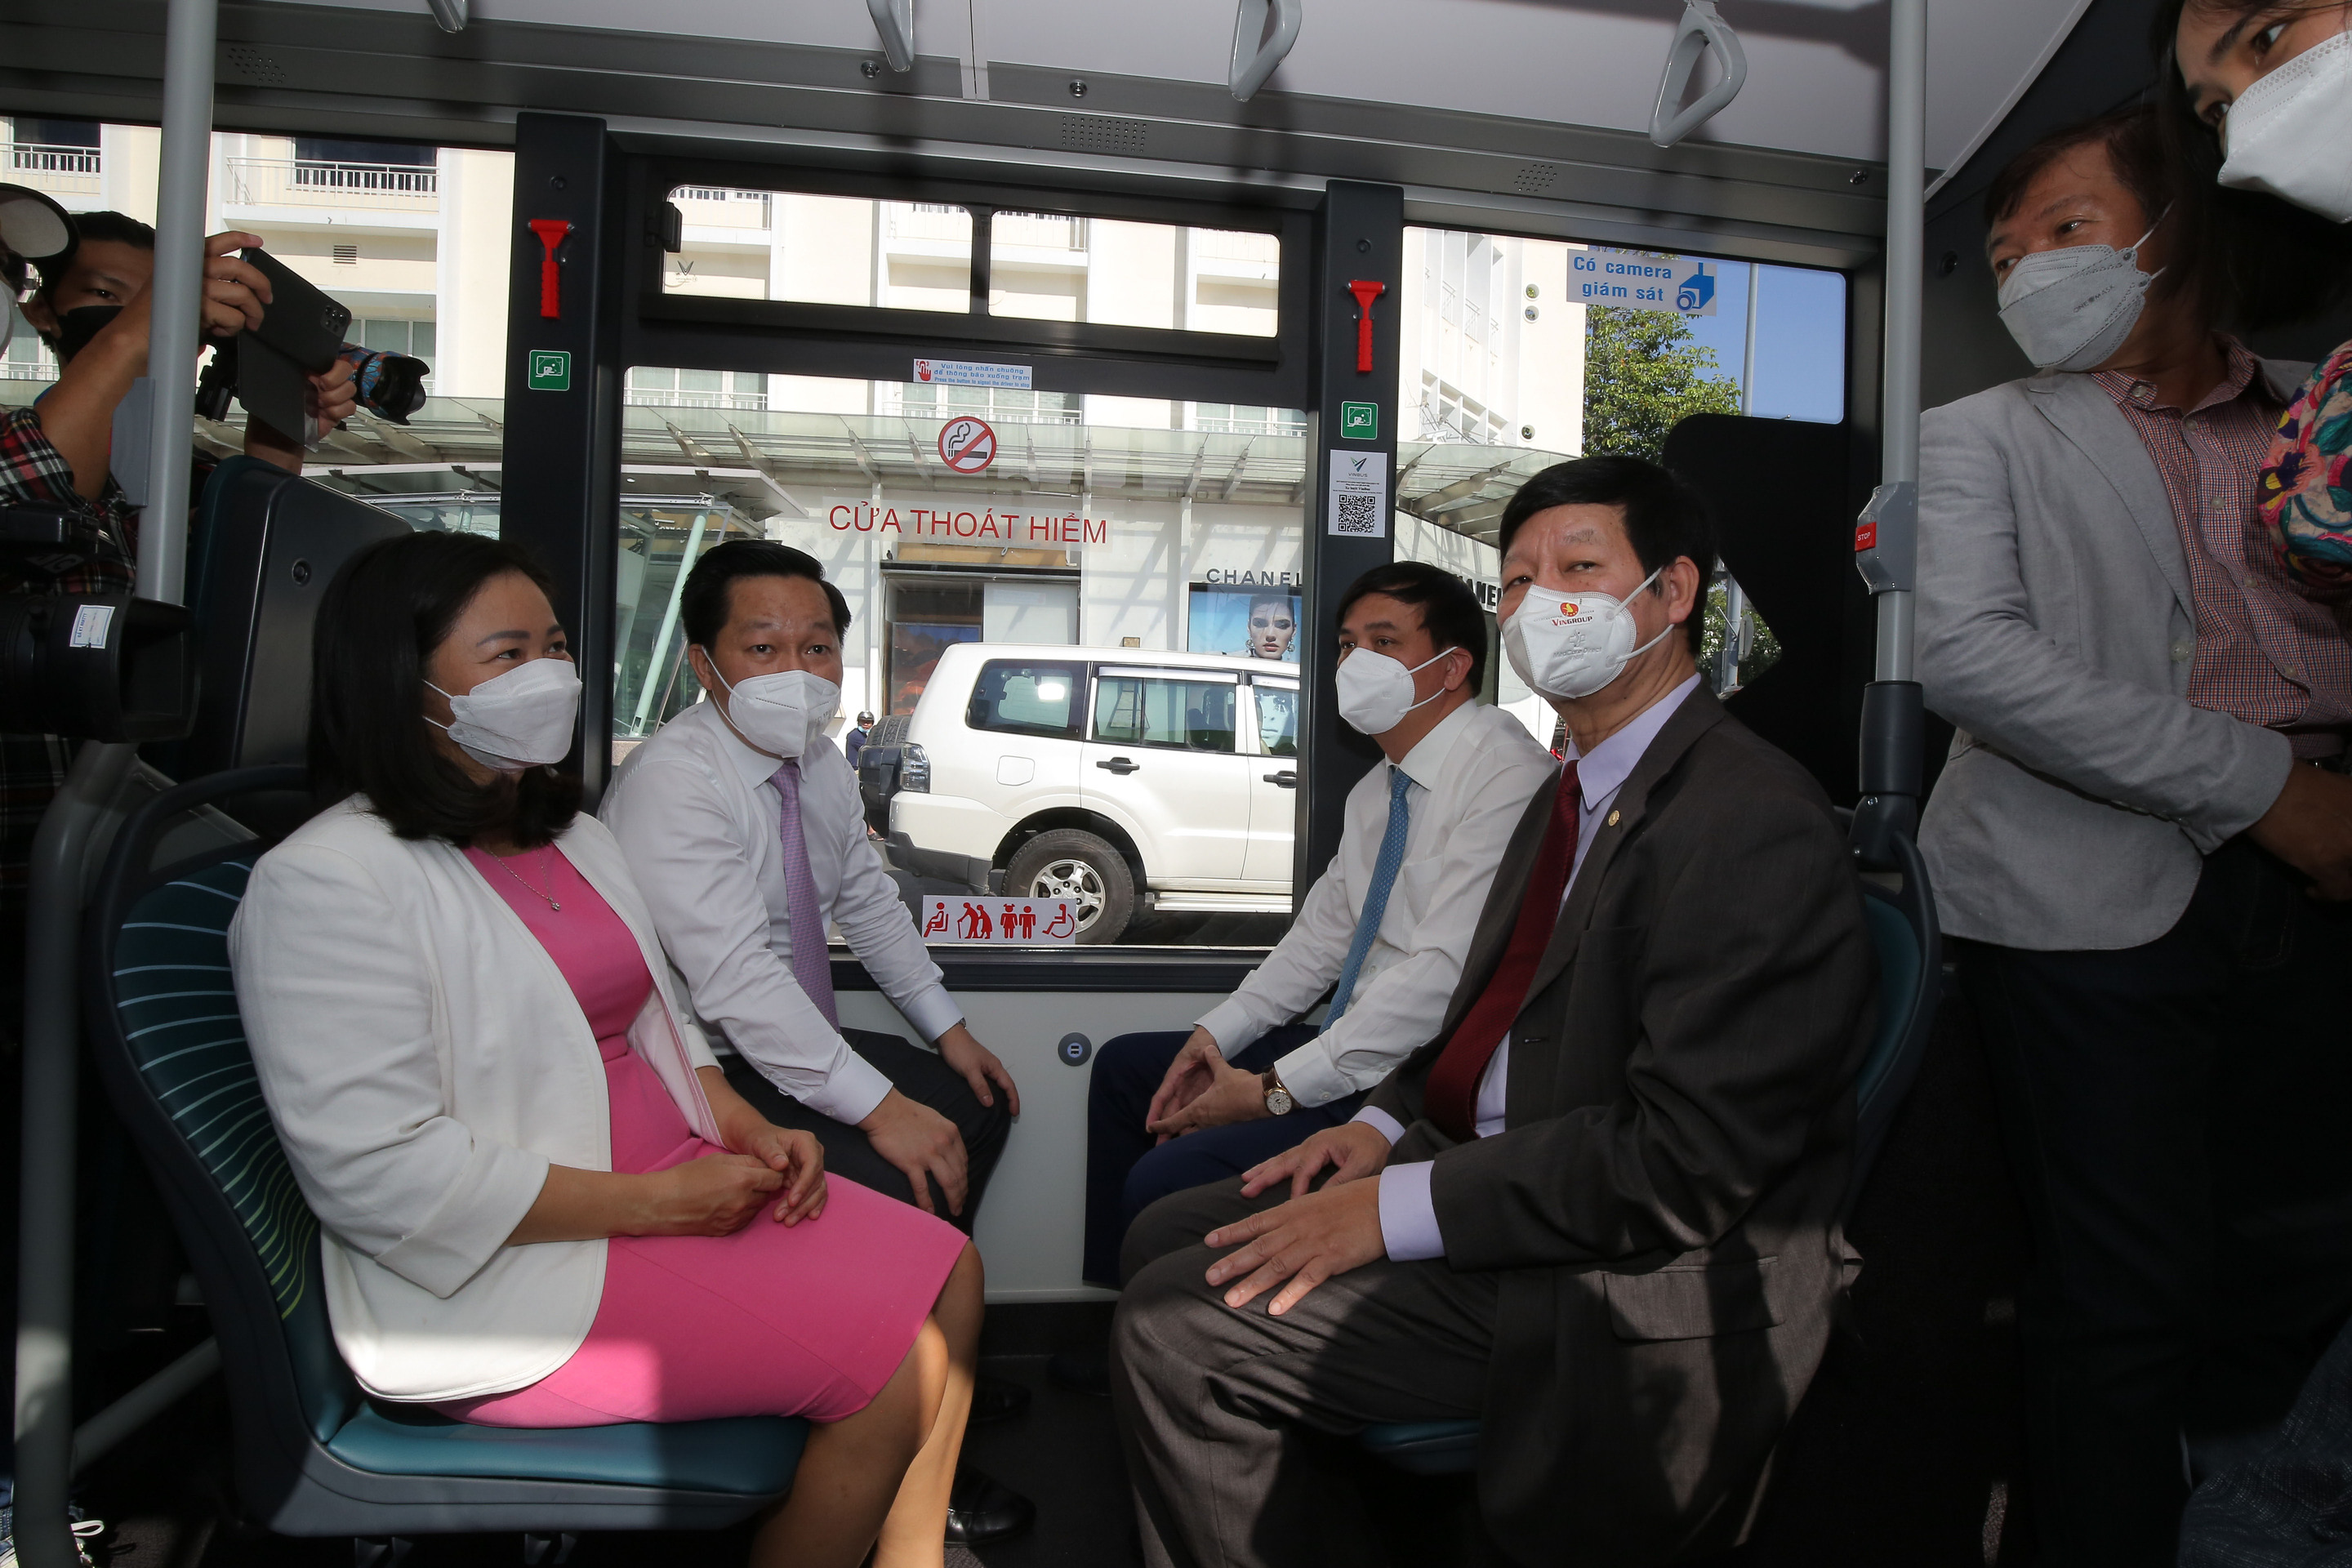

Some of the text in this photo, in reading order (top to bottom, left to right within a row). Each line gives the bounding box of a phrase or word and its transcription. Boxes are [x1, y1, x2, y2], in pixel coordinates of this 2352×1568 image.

[1574, 256, 1672, 279] Có camera
[1582, 281, 1664, 301] giám sát
[829, 501, 1107, 544] CỬA THOÁT HIỂM
[1857, 532, 1871, 541] STOP
